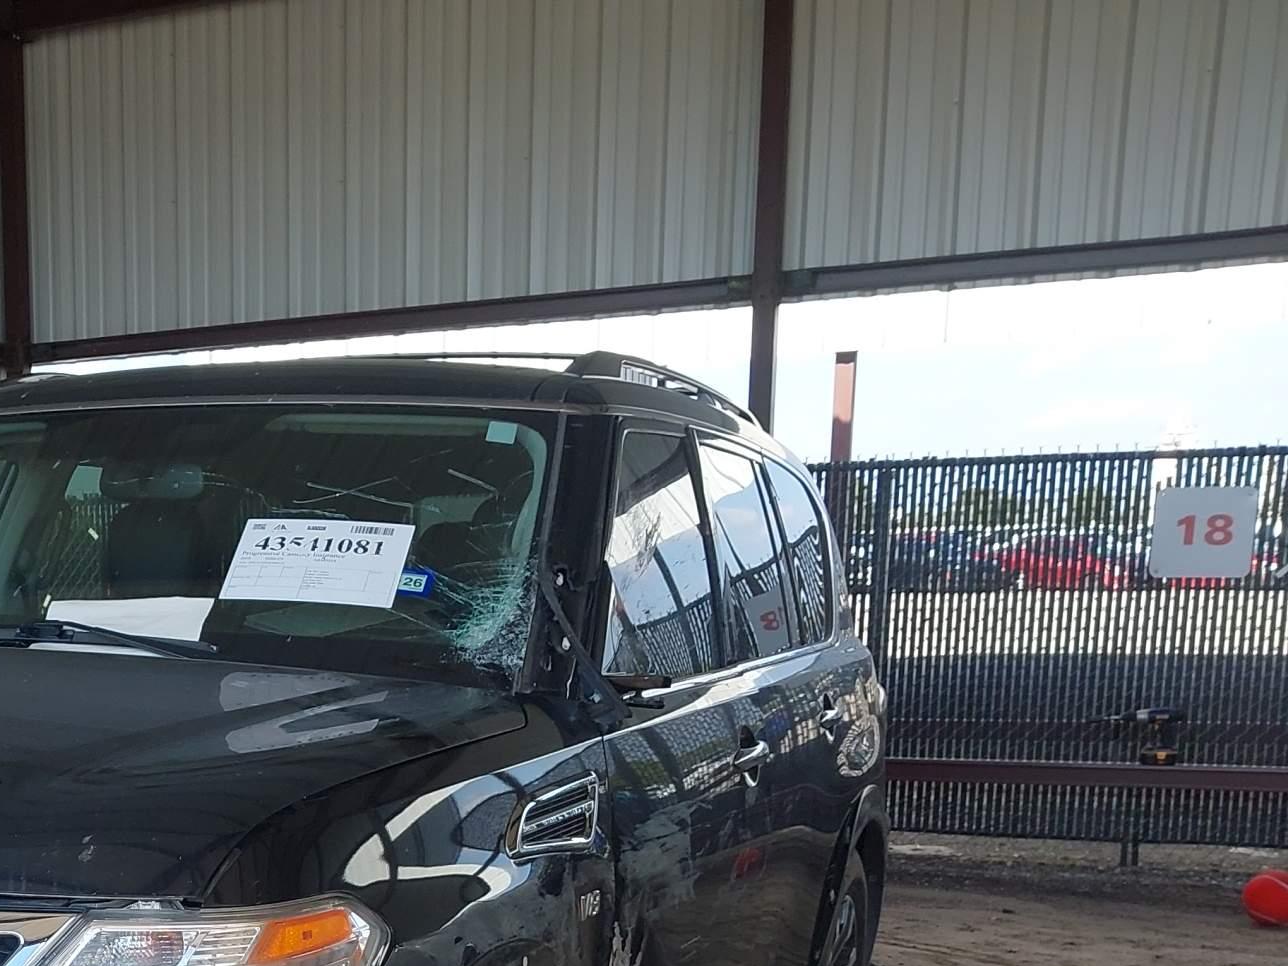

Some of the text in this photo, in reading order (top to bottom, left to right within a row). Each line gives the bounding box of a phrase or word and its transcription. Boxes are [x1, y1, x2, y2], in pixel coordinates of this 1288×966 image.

[1176, 513, 1235, 546] 18
[254, 535, 385, 556] 43541081
[402, 576, 424, 588] 26
